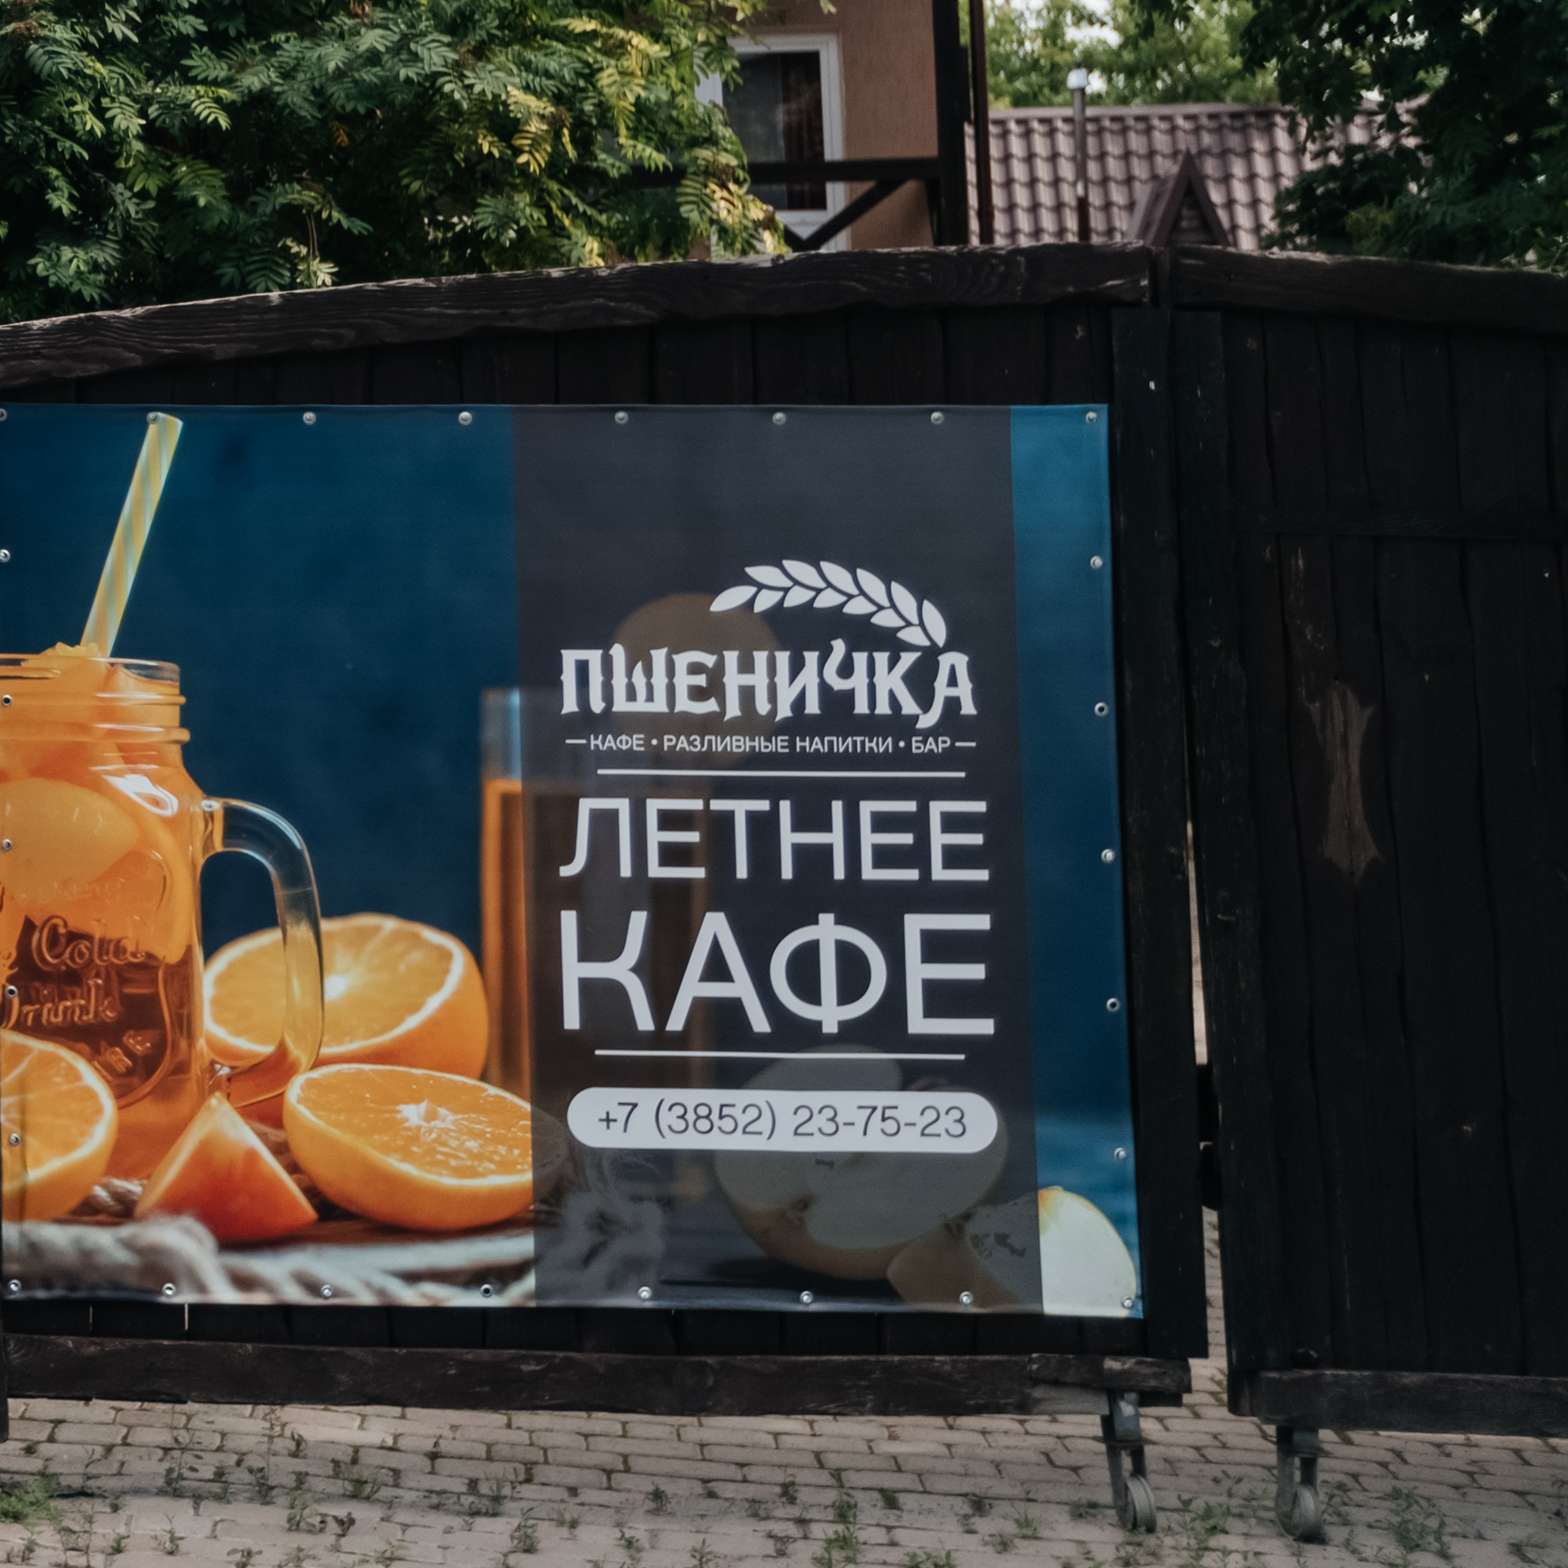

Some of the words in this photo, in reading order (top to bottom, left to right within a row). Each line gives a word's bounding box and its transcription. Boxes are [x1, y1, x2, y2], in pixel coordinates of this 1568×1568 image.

[560, 638, 977, 729] ПШЕНИЧКА
[591, 733, 645, 751] КАФЕ
[664, 734, 788, 753] РАЗЛИВНЫЕ
[796, 736, 893, 753] НАПИТКИ
[911, 736, 951, 754] БАР
[559, 797, 990, 881] ЛЕТНЕЕ
[560, 909, 995, 1035] КАФЕ
[598, 1102, 639, 1134] +7
[654, 1099, 778, 1141] (3852)
[793, 1104, 967, 1139] 23-75-23
